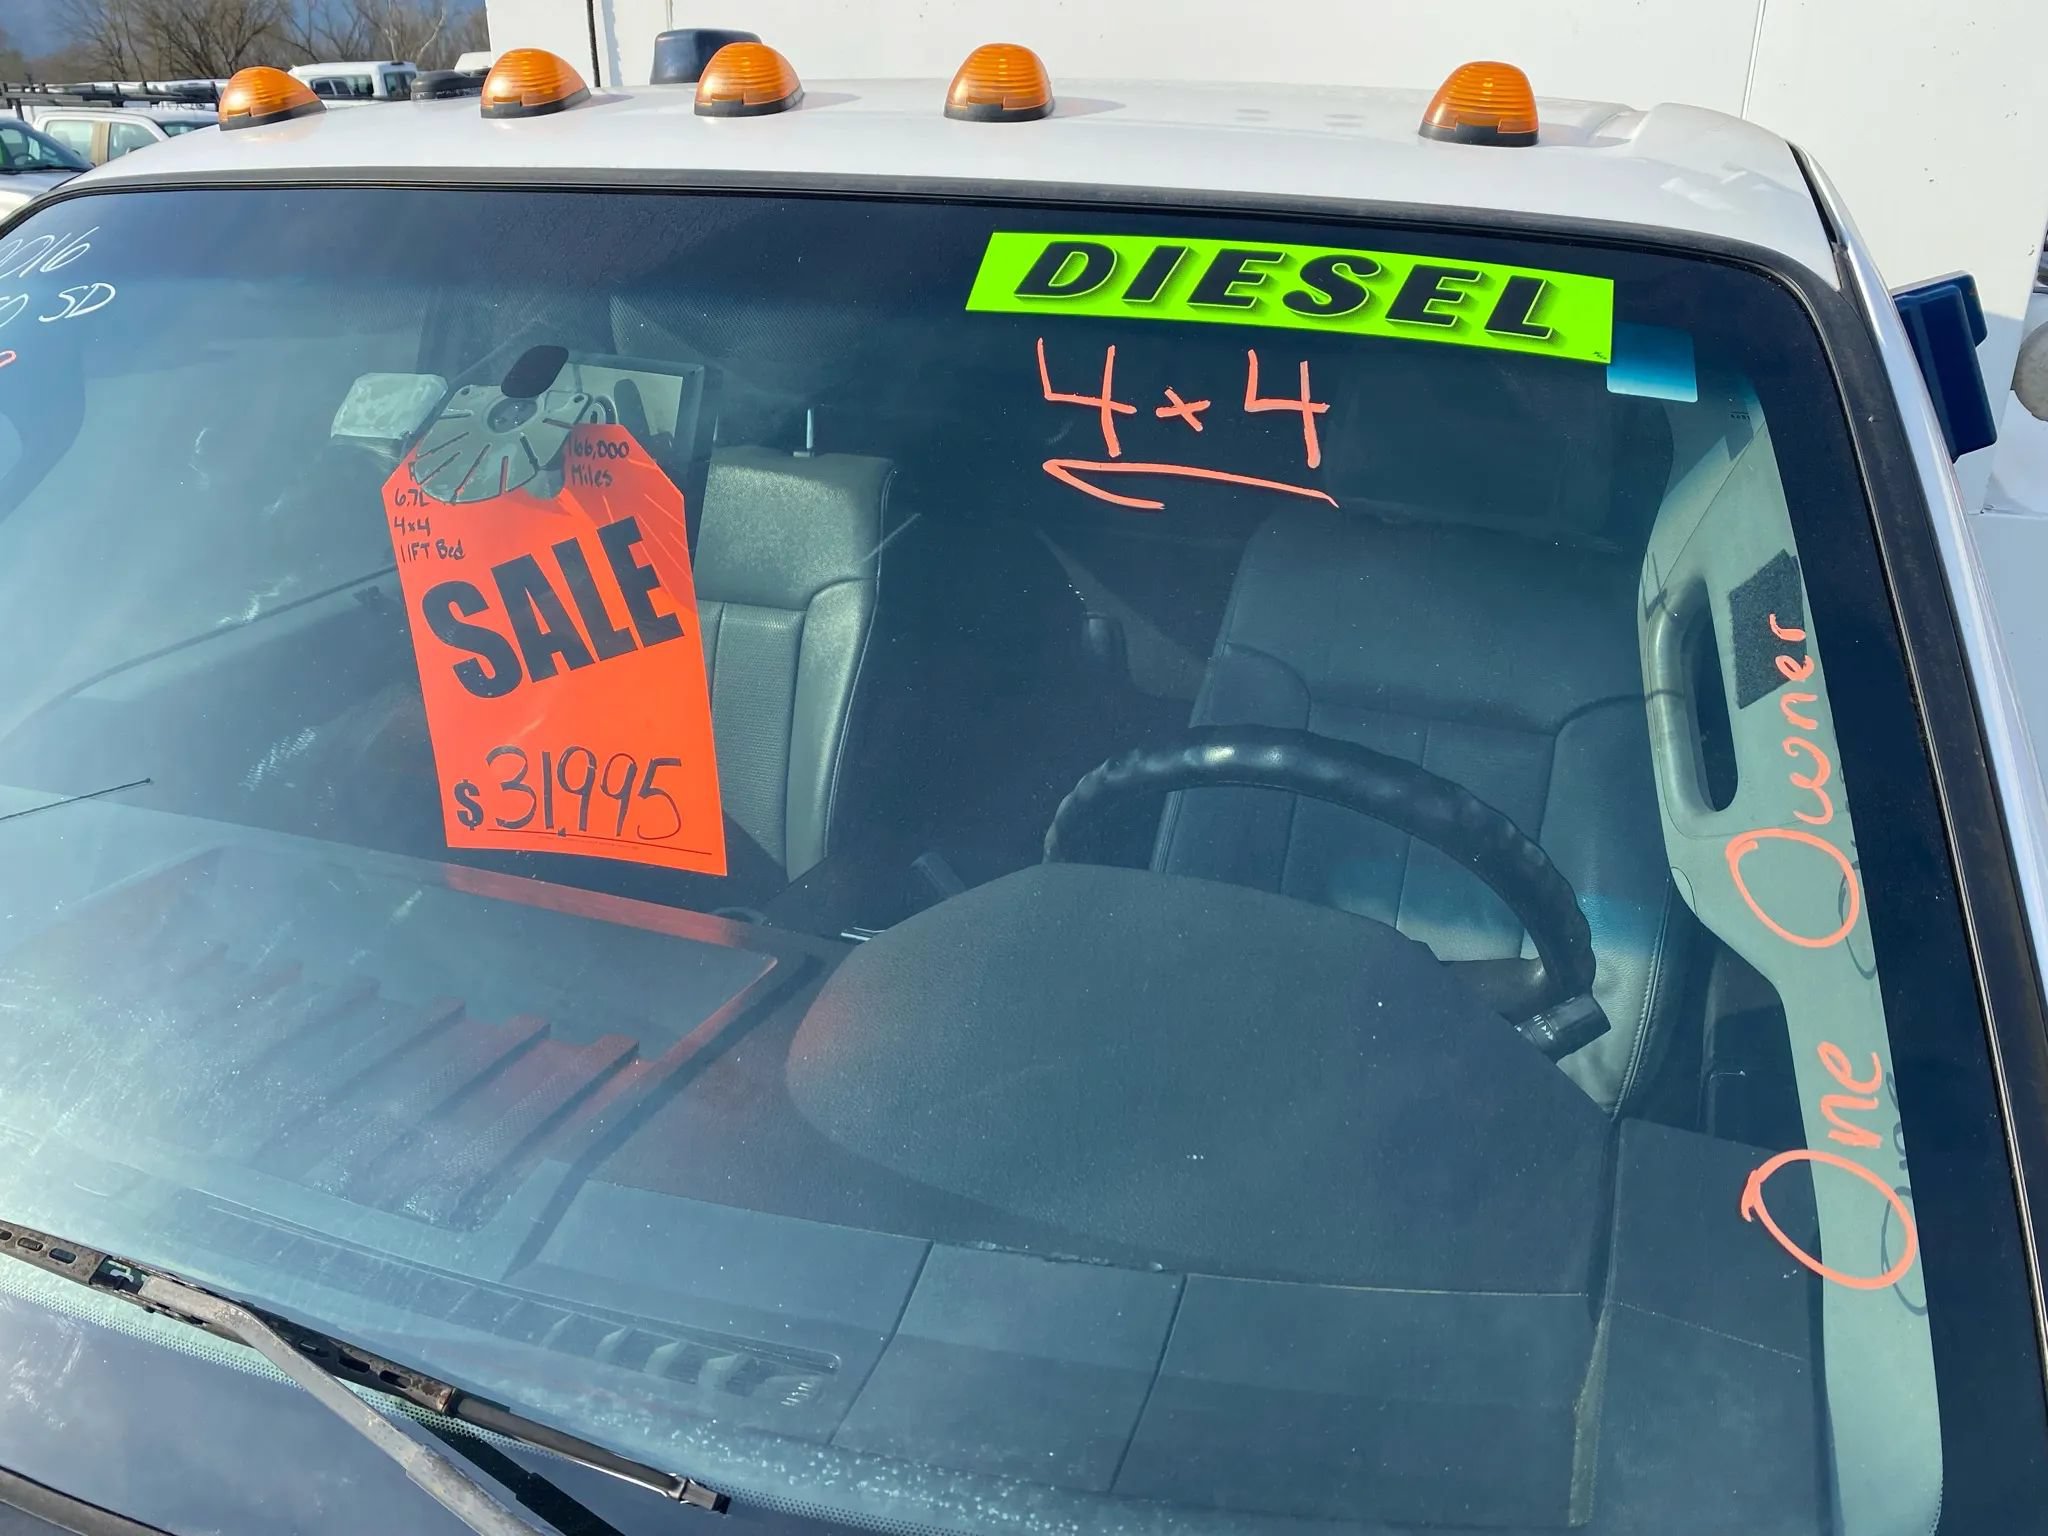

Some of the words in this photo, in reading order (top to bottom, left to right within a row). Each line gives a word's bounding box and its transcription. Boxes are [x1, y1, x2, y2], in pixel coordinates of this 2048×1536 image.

[38, 282, 116, 322] SD
[1013, 241, 1562, 342] DIESEL
[568, 437, 630, 460] 166,000
[571, 463, 613, 488] Miles
[394, 516, 431, 537] 4x4
[435, 538, 466, 560] Bed
[421, 515, 685, 699] SALE
[1725, 613, 1860, 948] Owner
[1741, 1041, 1917, 1290] One
